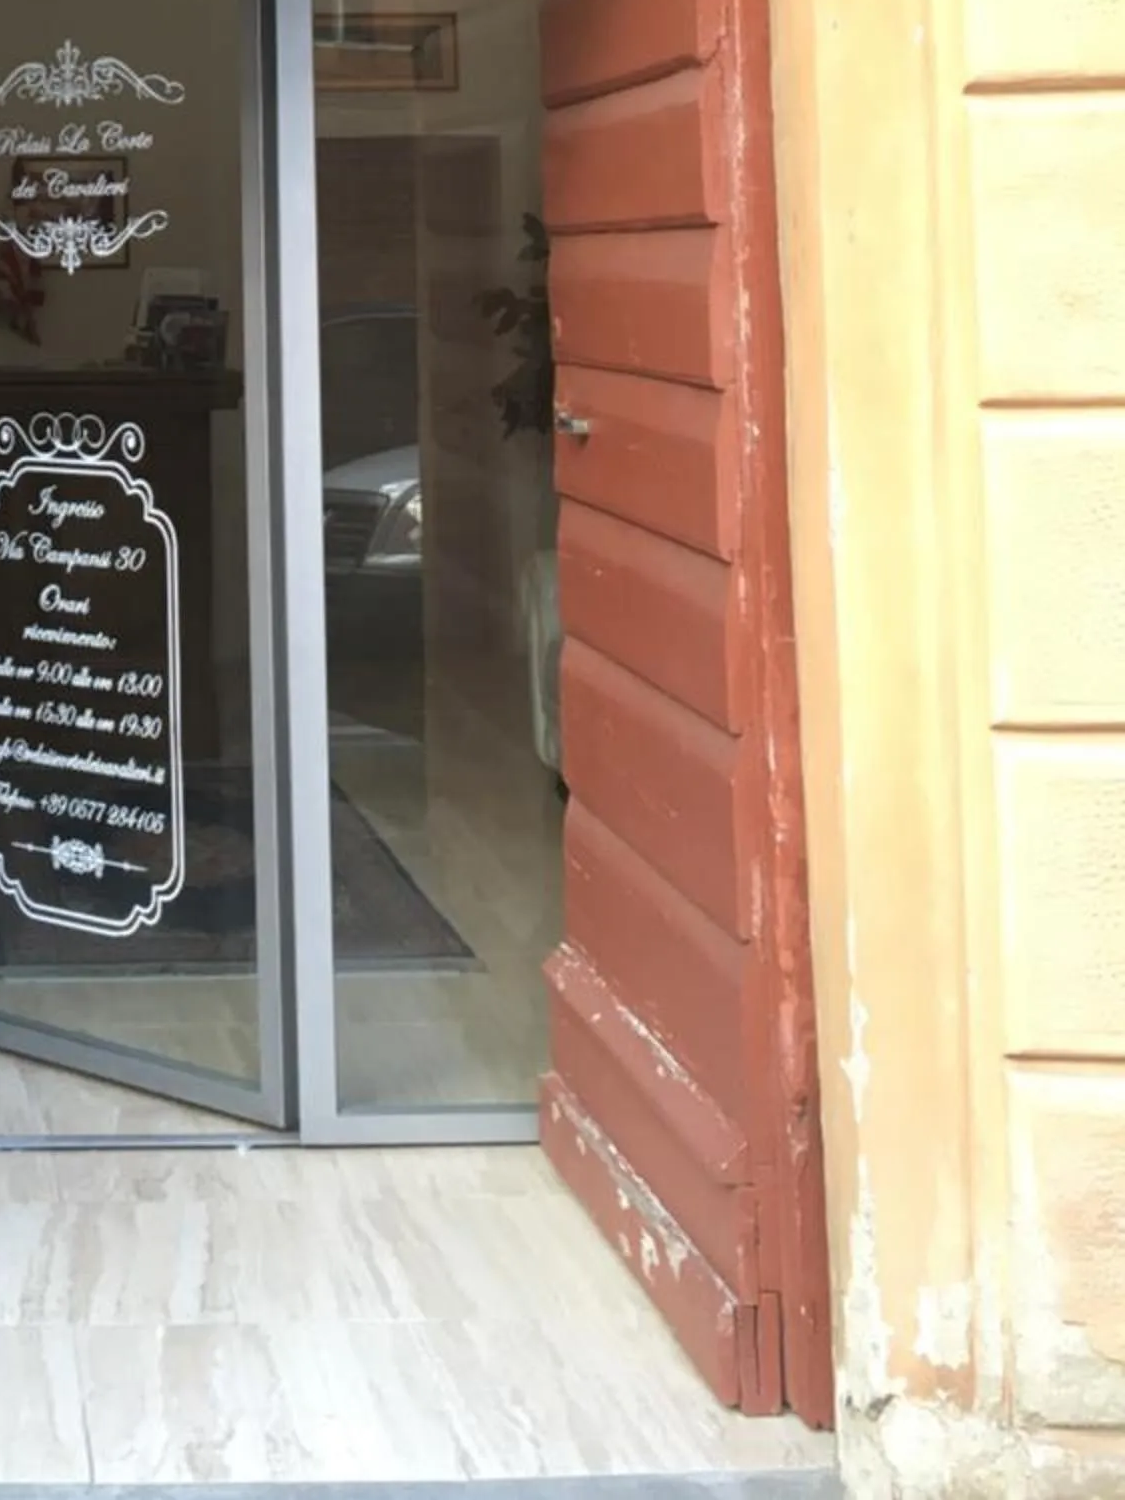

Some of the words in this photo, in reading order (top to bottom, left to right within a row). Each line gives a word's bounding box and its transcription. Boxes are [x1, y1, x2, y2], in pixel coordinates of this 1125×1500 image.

[56, 121, 91, 154] La
[96, 119, 154, 151] Corte
[11, 175, 39, 200] dei
[43, 167, 131, 199] Cavalieri
[28, 484, 105, 530] Ingresso
[114, 546, 147, 573] 30
[38, 583, 91, 616] Orari
[67, 798, 107, 823] 0577
